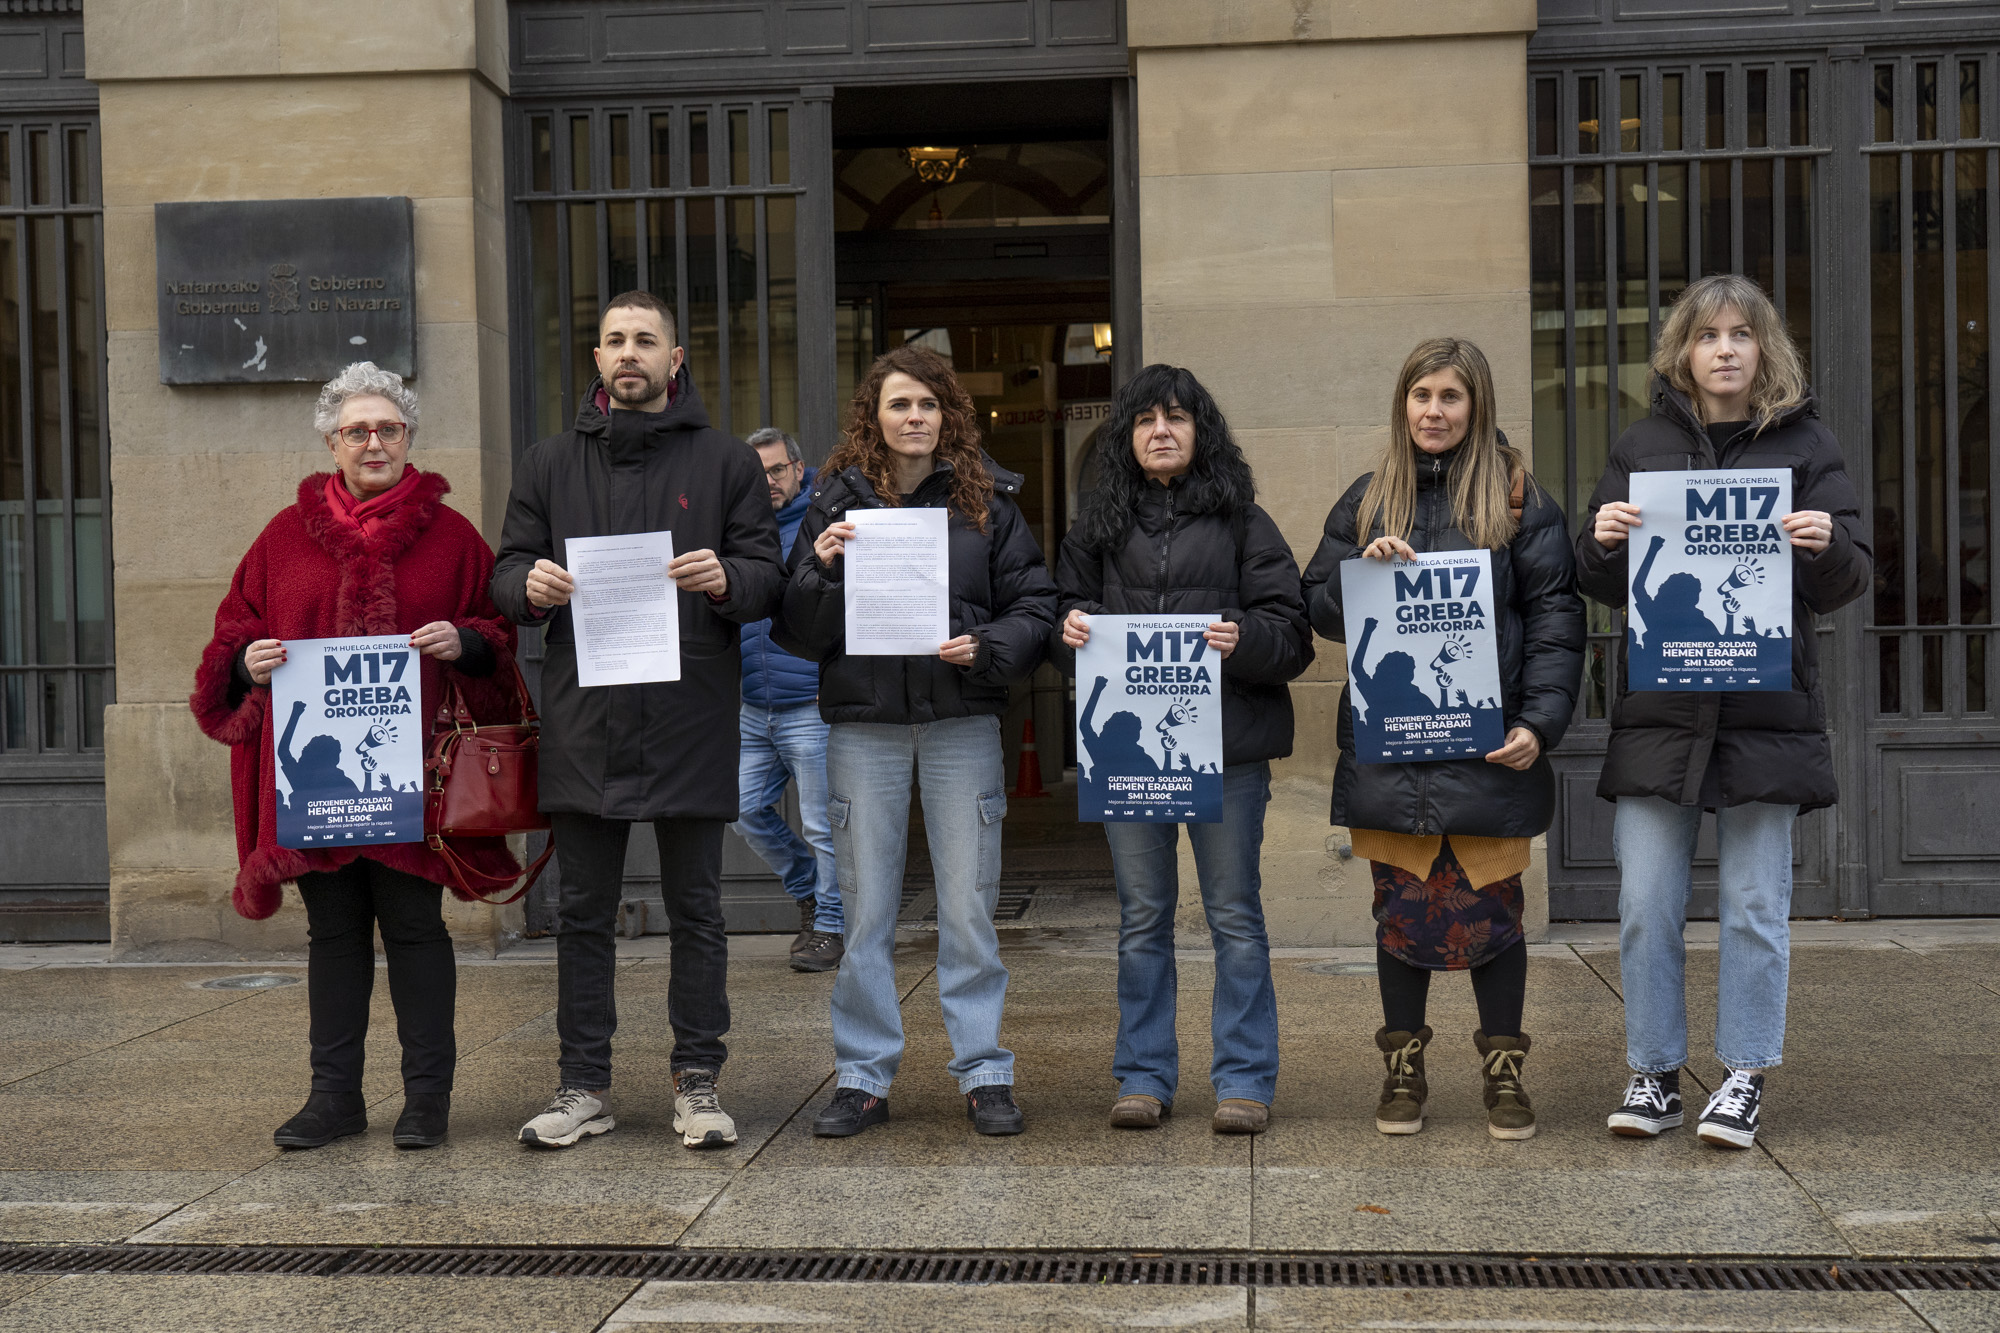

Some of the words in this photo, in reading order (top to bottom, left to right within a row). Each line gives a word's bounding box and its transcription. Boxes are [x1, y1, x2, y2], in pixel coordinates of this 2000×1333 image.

[165, 279, 260, 295] Nafarroako
[308, 275, 386, 291] Gobierno
[177, 300, 260, 315] Gobernua
[308, 298, 329, 312] de
[335, 296, 401, 311] Navarra
[1686, 486, 1780, 522] M17
[1684, 523, 1782, 543] GREBA
[1684, 543, 1781, 556] OROKORRA
[1408, 560, 1441, 568] HUELGA
[1442, 557, 1479, 565] GENERAL
[1393, 566, 1481, 602] M17
[1395, 600, 1485, 623] GREBA
[1396, 619, 1485, 635] OROKORRA
[339, 644, 371, 652] HUELGA
[372, 642, 409, 650] GENERAL
[1126, 631, 1208, 663] M17
[1662, 641, 1715, 649] GUTXIENEKO
[1663, 648, 1704, 657] HEMEN
[1706, 648, 1757, 657] ERABAKI
[324, 651, 409, 686] M17
[1684, 659, 1702, 667] SMI
[1703, 658, 1734, 667] 1.500€
[1125, 666, 1212, 684] GREBA
[324, 685, 412, 707] GREBA
[1125, 684, 1211, 695] OROKORRA
[324, 703, 411, 719] OROKORRA
[1383, 714, 1433, 724] GUTXIENEKO
[1435, 712, 1471, 721] SOLDATA
[1385, 722, 1422, 732] HEMEN
[1425, 719, 1471, 730] ERABAKI
[1405, 732, 1421, 740] SMI
[1422, 730, 1451, 739] 1.500€
[1108, 782, 1145, 791] HEMEN
[1147, 782, 1192, 791] ERABAKI
[307, 798, 355, 808] GUTXIENEKO
[358, 796, 393, 805] SOLDATA
[1127, 792, 1143, 800] SMI
[1144, 792, 1172, 800] 1.500€
[308, 806, 345, 816] HEMEN
[347, 803, 393, 814] ERABAKI
[327, 816, 343, 824] SMI
[344, 814, 372, 823] 1.500€
